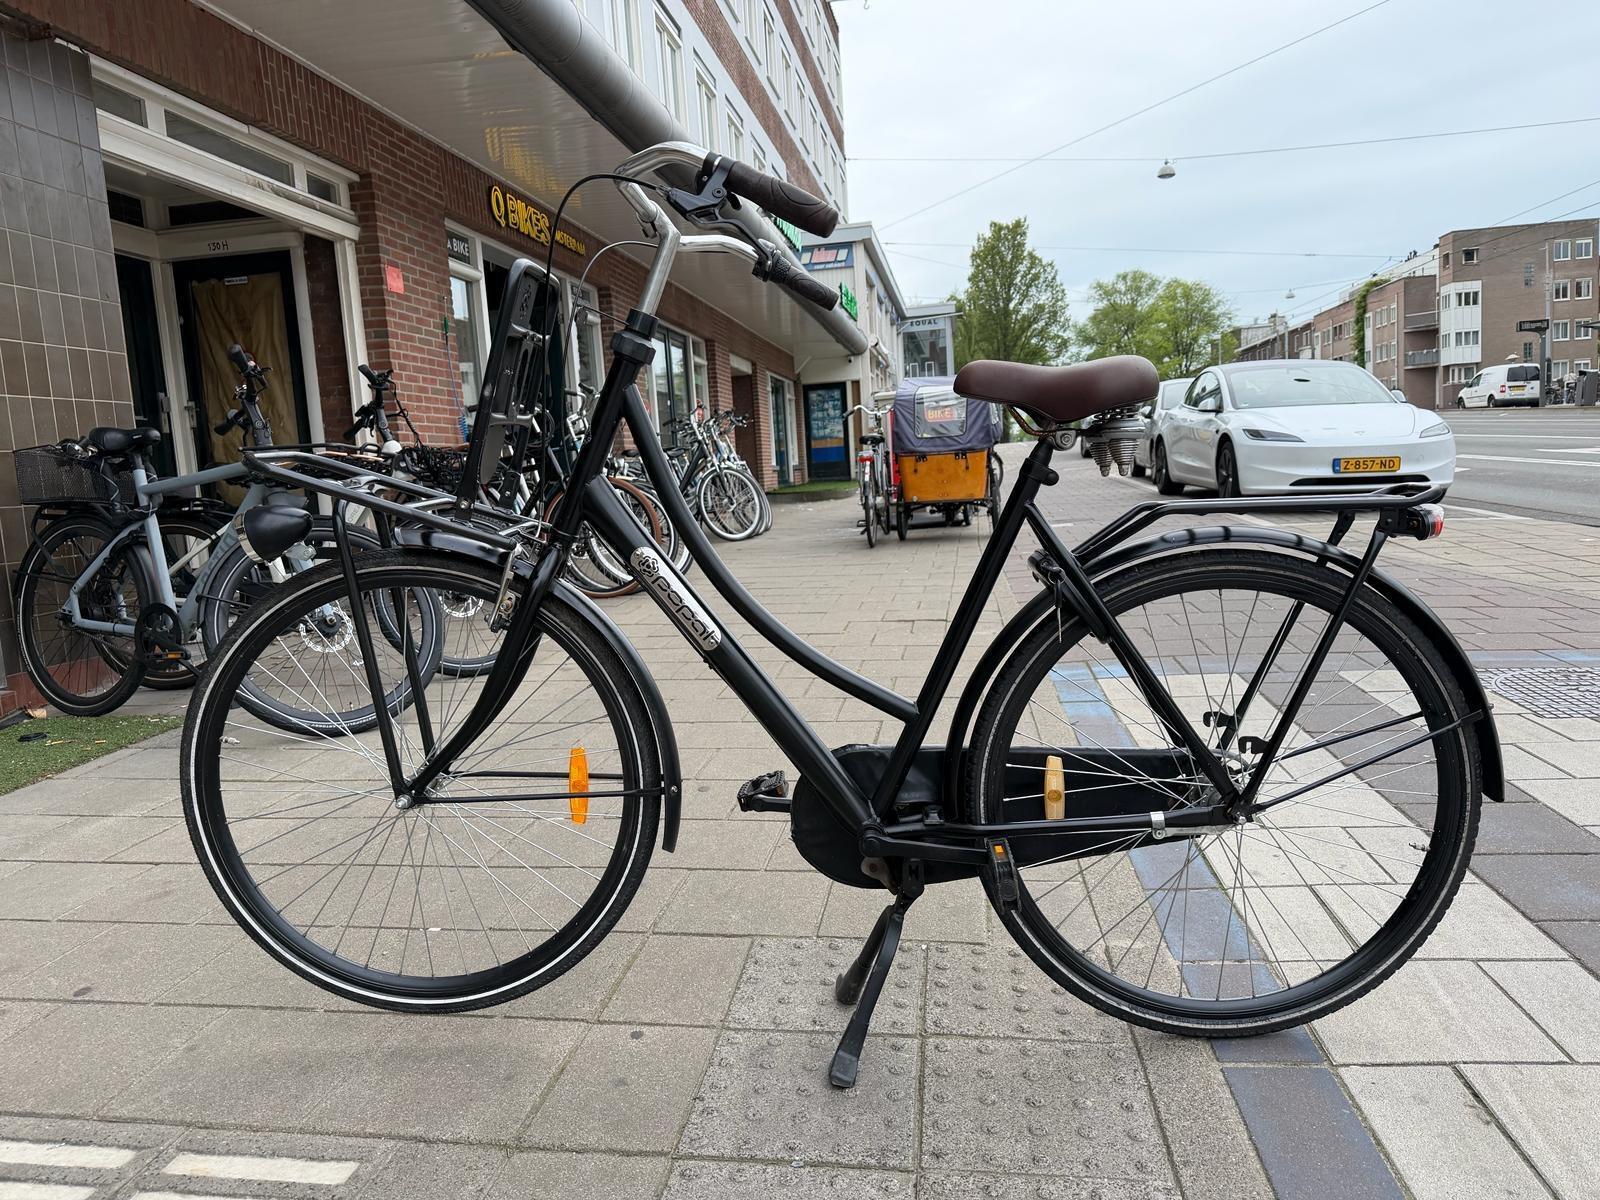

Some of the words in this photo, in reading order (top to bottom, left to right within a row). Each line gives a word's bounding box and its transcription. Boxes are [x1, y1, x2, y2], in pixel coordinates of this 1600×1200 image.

[491, 186, 506, 227] Q
[506, 193, 550, 247] BIKES
[555, 230, 586, 256] MSTERDAM
[208, 241, 221, 251] 130
[222, 240, 229, 251] H
[452, 238, 469, 256] BIKE
[910, 318, 939, 327] EQUAL
[1343, 459, 1396, 470] Z-857-ND
